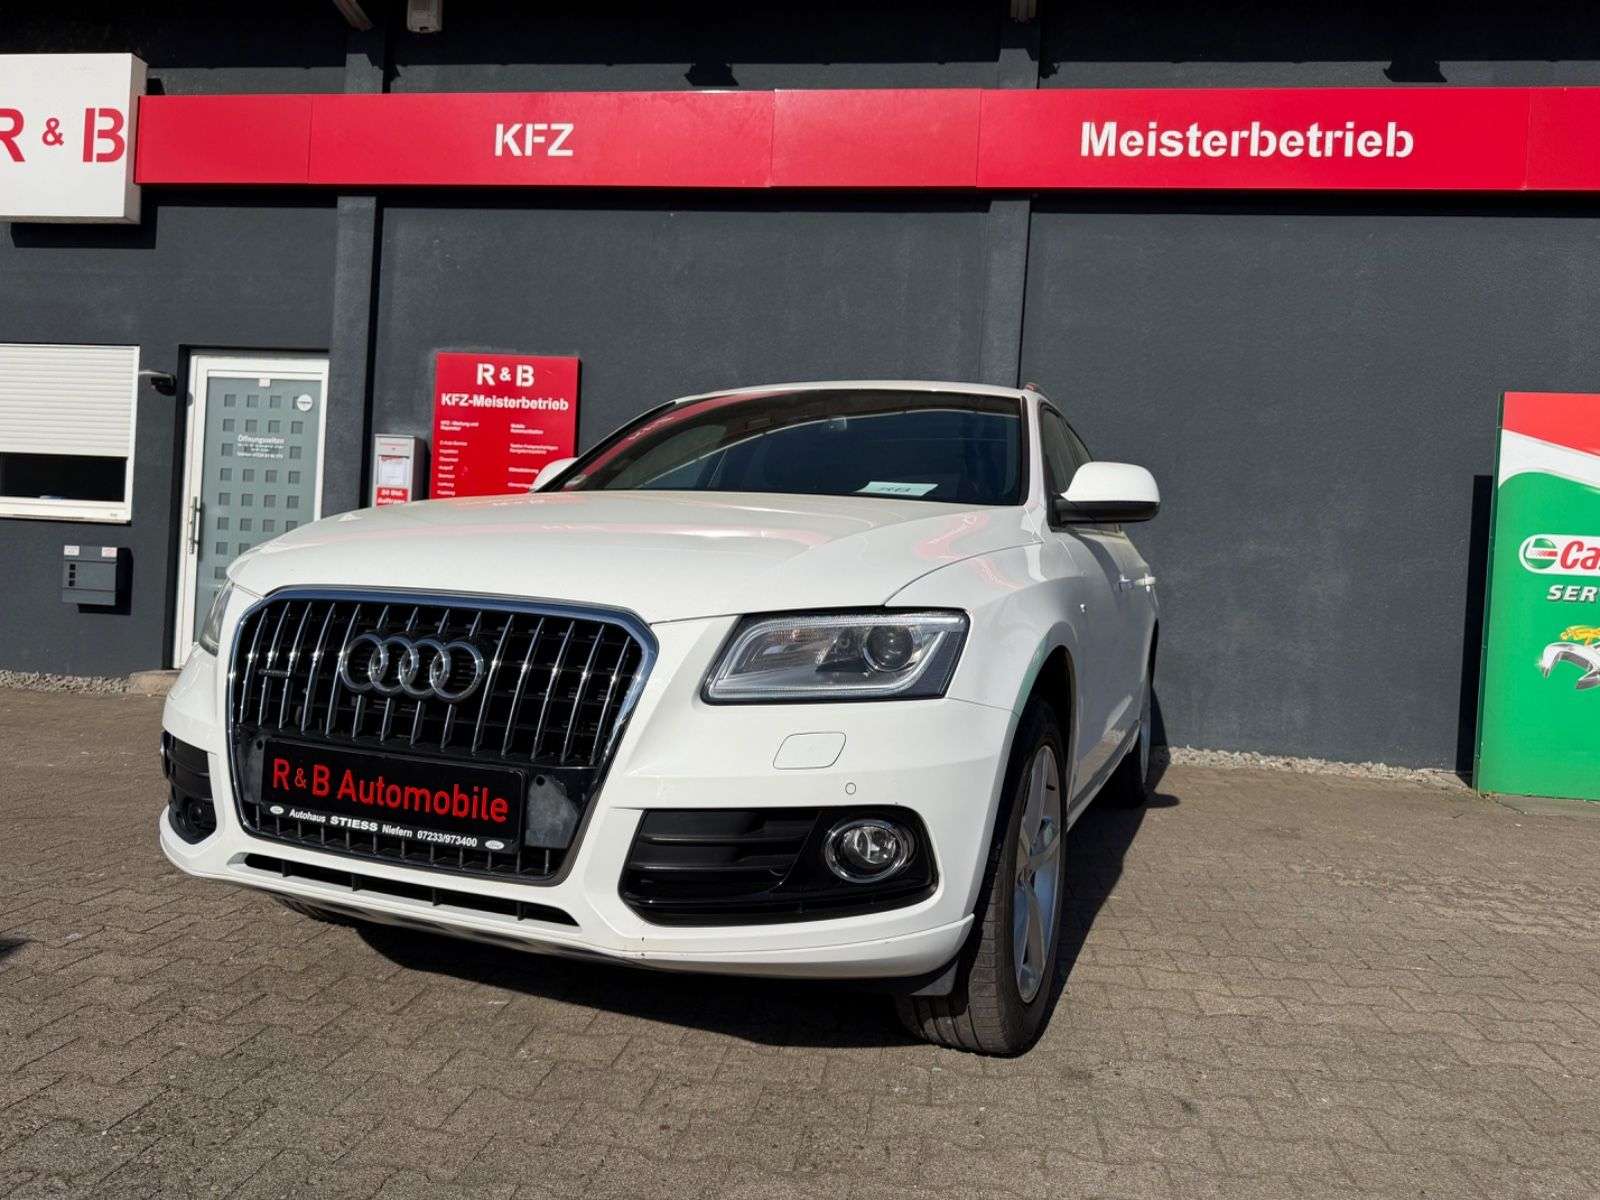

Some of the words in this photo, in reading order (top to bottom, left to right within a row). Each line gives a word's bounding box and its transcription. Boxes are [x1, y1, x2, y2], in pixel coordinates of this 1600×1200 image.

[0, 108, 25, 162] R
[42, 117, 64, 146] &
[83, 108, 125, 162] B
[495, 123, 574, 157] KFZ
[1080, 121, 1414, 158] Meisterbetrieb
[476, 363, 496, 386] R
[499, 367, 512, 381] &
[516, 365, 535, 387] B
[440, 392, 569, 411] KFZ-Meisterbetrieb
[1560, 540, 1600, 570] Ca
[273, 758, 290, 791] R
[294, 767, 308, 789] &
[312, 765, 330, 797] B
[338, 770, 509, 823] Automobile
[289, 808, 327, 824] Autohaus
[329, 815, 379, 832] STIESS
[381, 823, 413, 838] Niefern
[416, 830, 478, 848] 07233/973400
